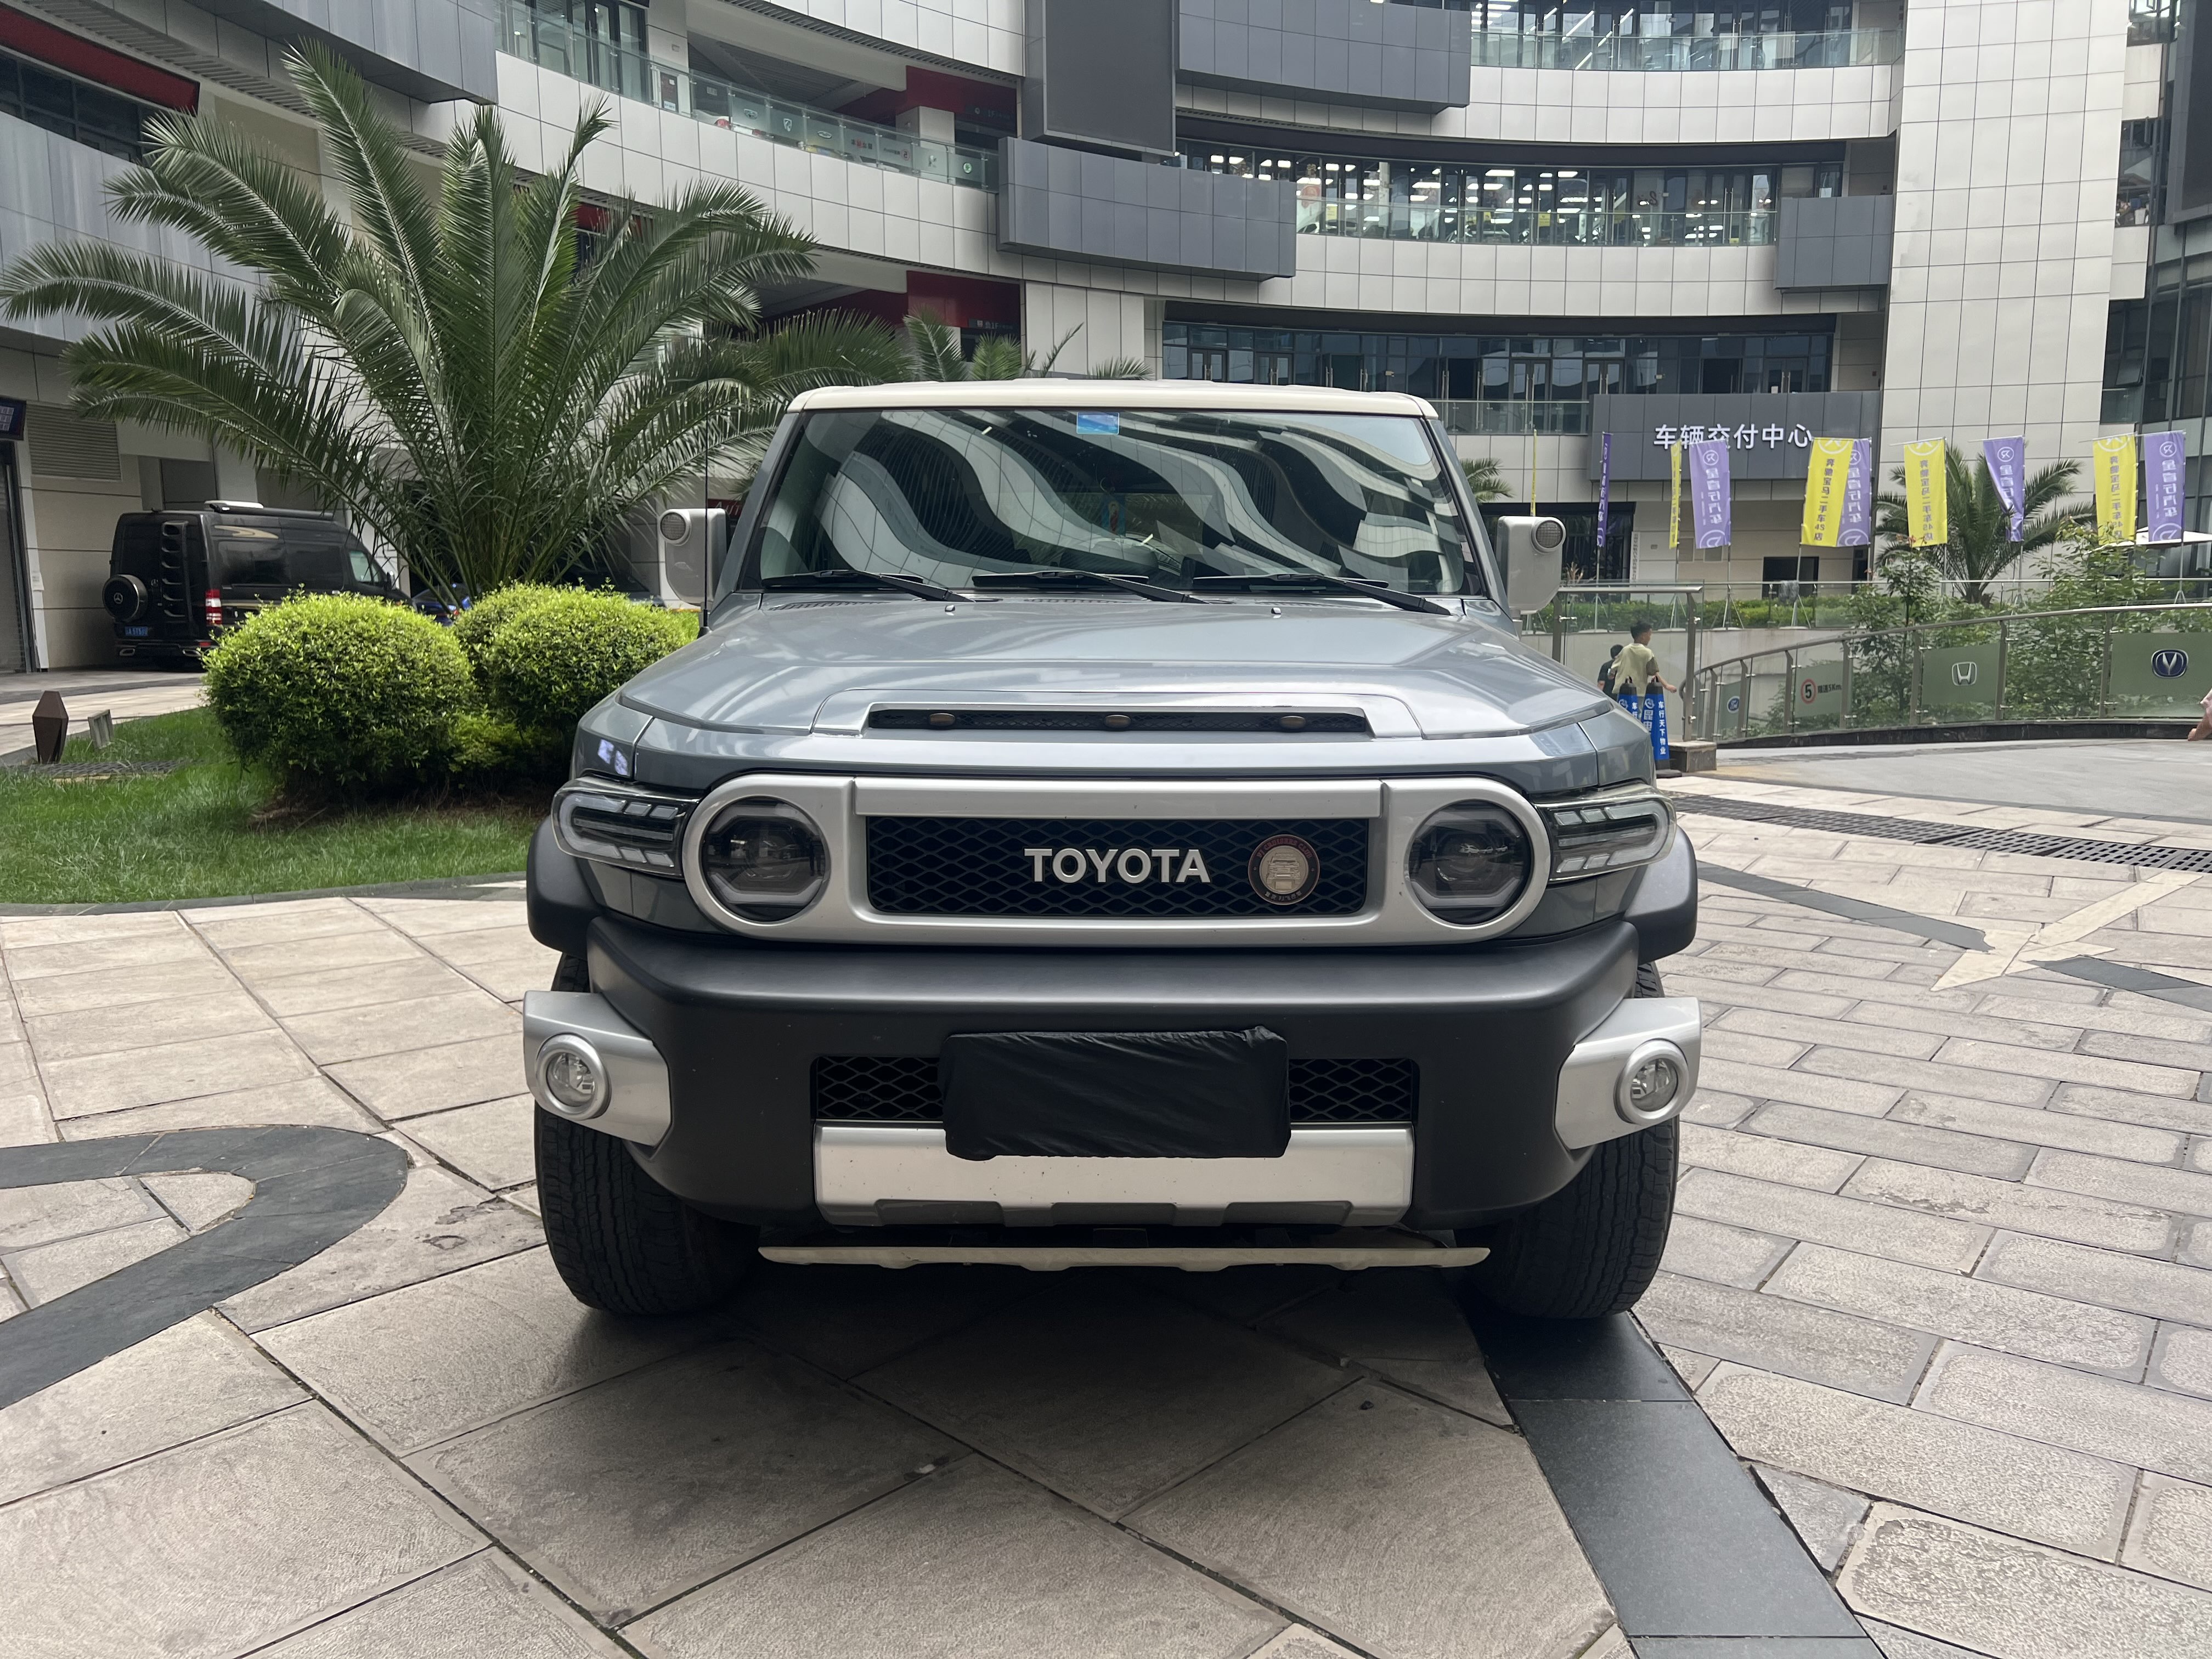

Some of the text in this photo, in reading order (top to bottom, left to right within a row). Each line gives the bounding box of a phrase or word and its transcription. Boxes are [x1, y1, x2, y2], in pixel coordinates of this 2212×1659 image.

[1654, 423, 1813, 449] 车辆交付中心
[1814, 459, 1835, 541] 奔驰宝马二手车4S店
[1805, 684, 1812, 698] 5
[1658, 701, 1666, 755] 车行天下物业
[1024, 848, 1211, 884] TOYOTA
